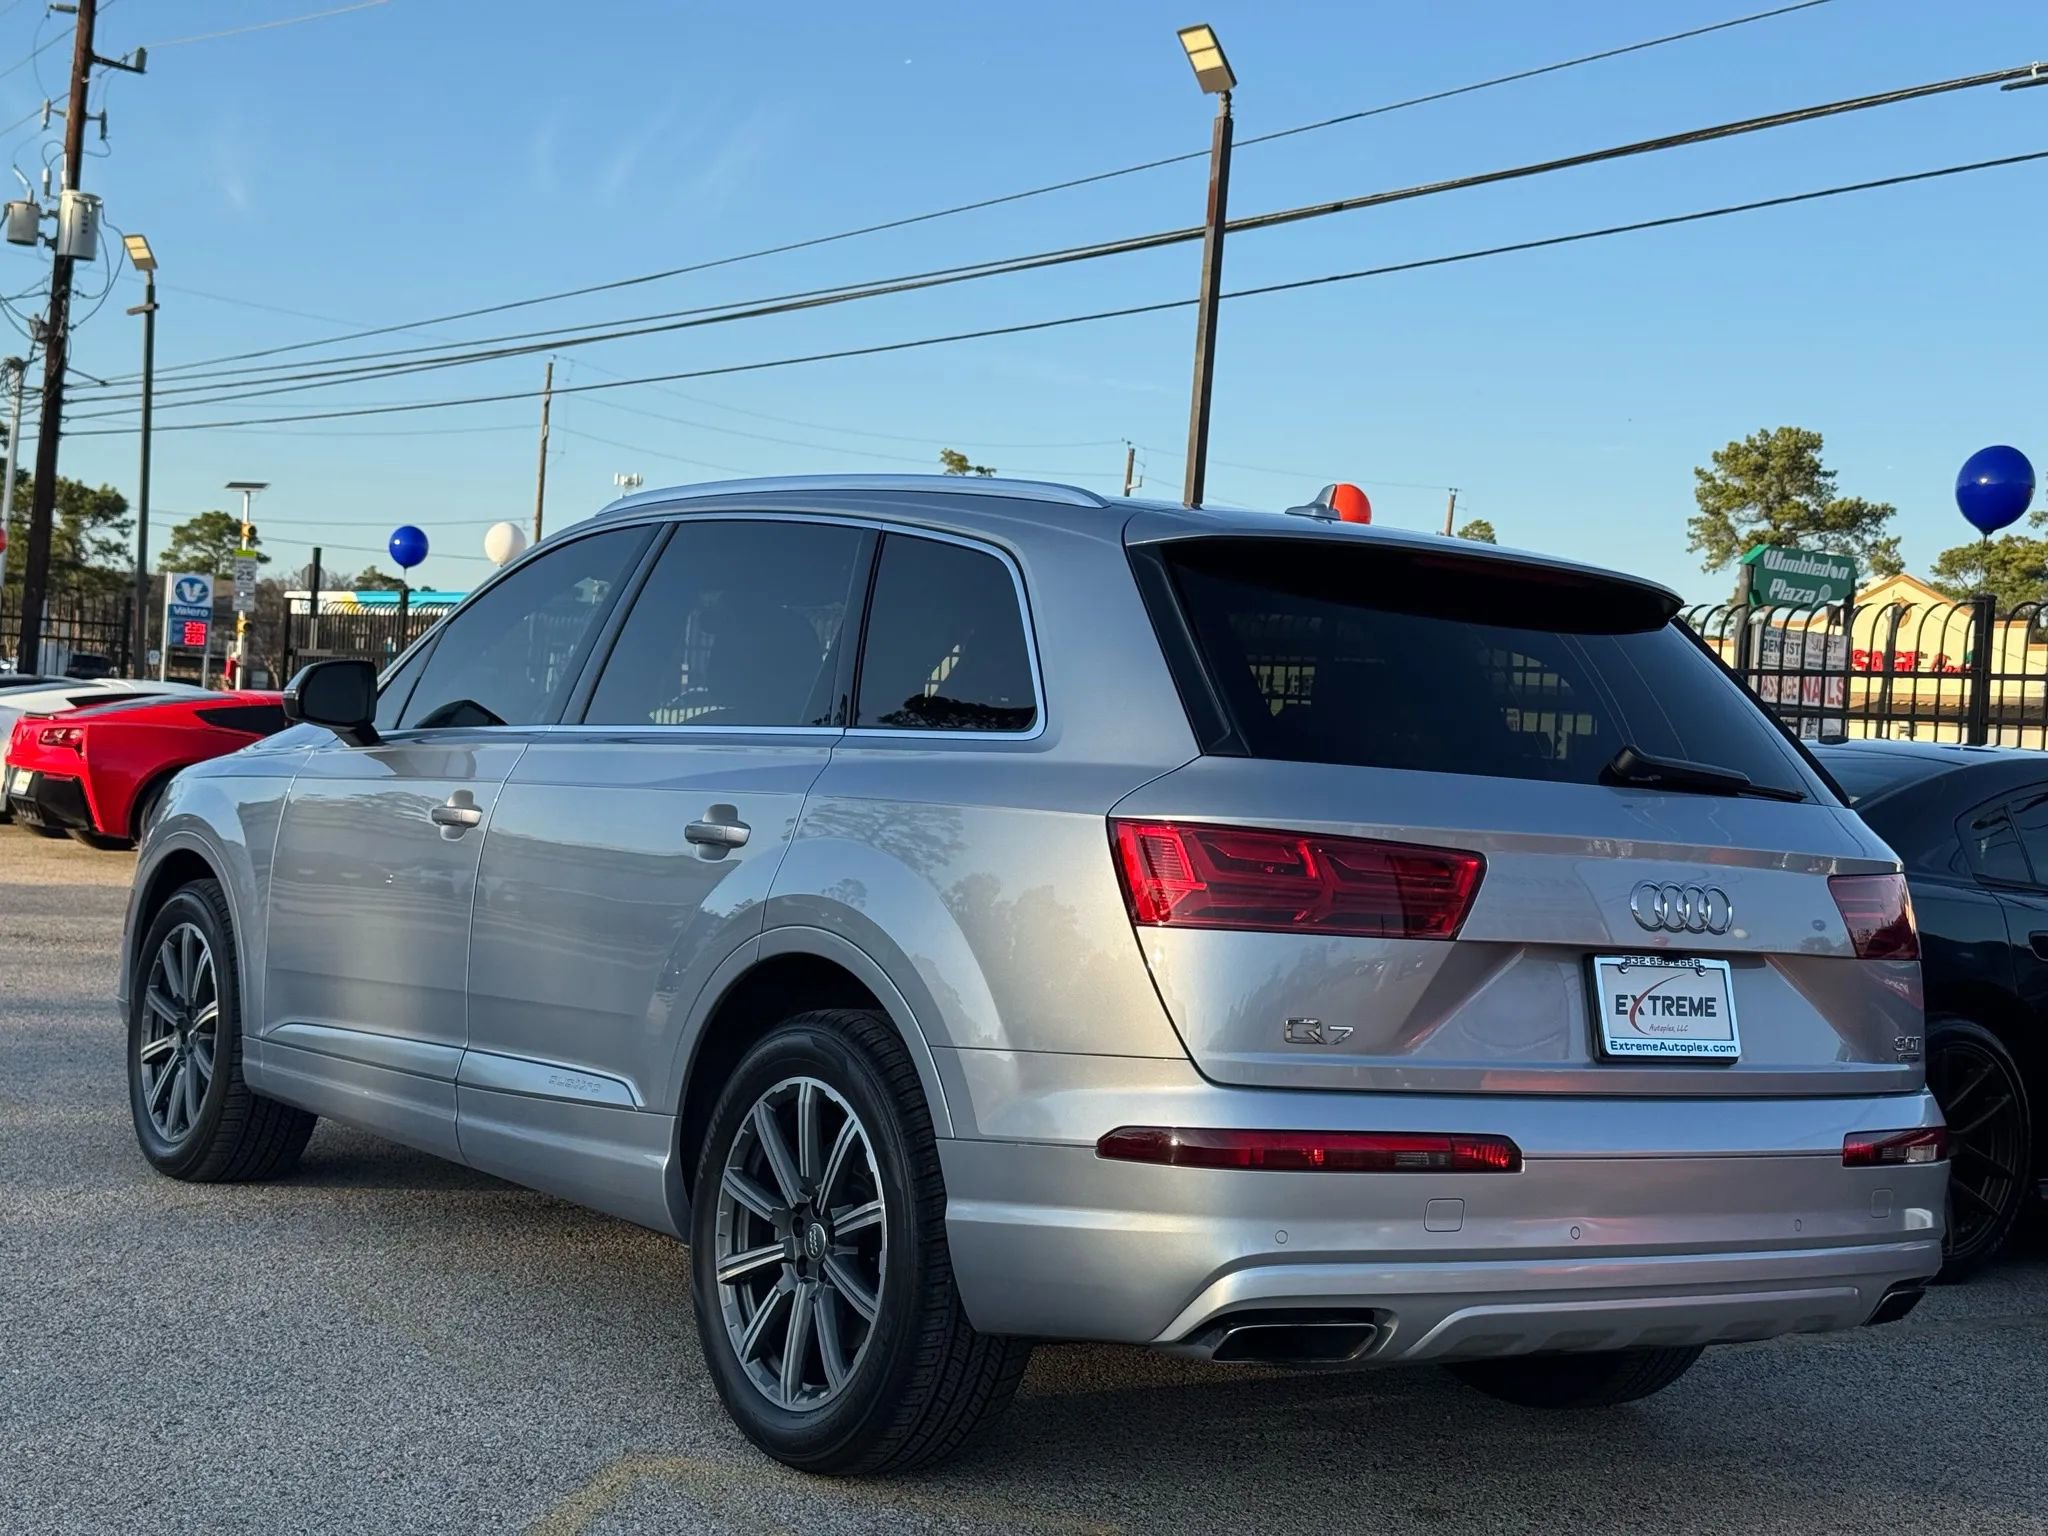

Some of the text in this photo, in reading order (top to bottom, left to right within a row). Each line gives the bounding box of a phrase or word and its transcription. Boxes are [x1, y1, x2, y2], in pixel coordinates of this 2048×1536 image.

[237, 570, 255, 581] 25
[1763, 549, 1850, 580] Wimbledon
[1769, 578, 1816, 603] Plaza
[173, 605, 208, 617] Valero
[1762, 638, 1800, 657] DENIST
[1802, 676, 1845, 705] NALS
[1615, 994, 1717, 1018] EXTREME
[1284, 1018, 1354, 1045] Q7
[1610, 1041, 1737, 1054] ExtremeAutoplex.com
